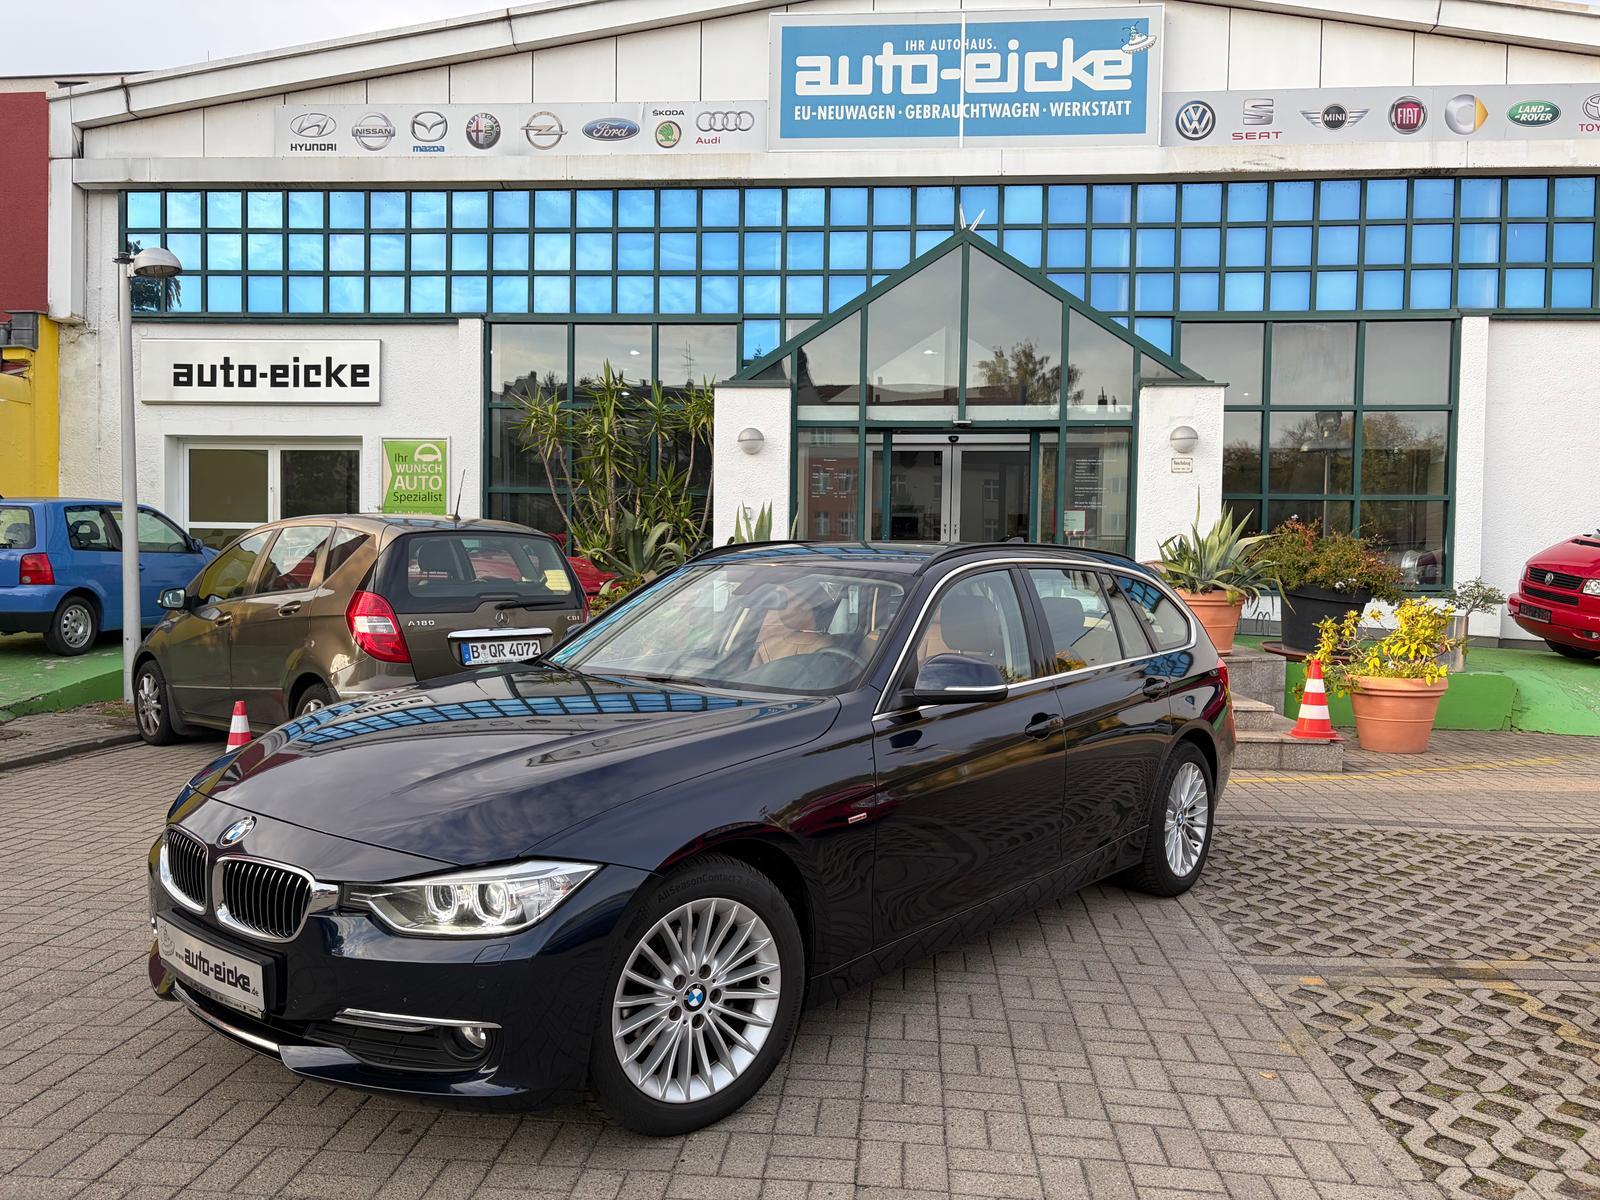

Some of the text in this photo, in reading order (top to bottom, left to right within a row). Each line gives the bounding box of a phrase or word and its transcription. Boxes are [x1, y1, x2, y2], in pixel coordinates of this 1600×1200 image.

[905, 39, 925, 51] IHR
[795, 37, 1133, 96] auto-eicke
[794, 100, 1132, 121] EU-NEUWAGEN GEBRAUCHTWAGEN WERKSTATT
[1518, 105, 1543, 113] LAND
[1397, 107, 1419, 124] FIAT
[1521, 113, 1552, 121] ROVER
[355, 128, 392, 136] NISSAN
[593, 122, 629, 138] Ford
[1232, 131, 1282, 141] SEAT
[695, 136, 721, 144] Audi
[290, 143, 337, 152] HYUNDAI
[173, 356, 370, 387] auto-eicke
[394, 452, 408, 463] Ihr
[395, 463, 442, 473] WUNSCH
[393, 475, 442, 491] AUTO
[393, 491, 442, 504] Spezialist
[471, 642, 539, 659] B QR 4072
